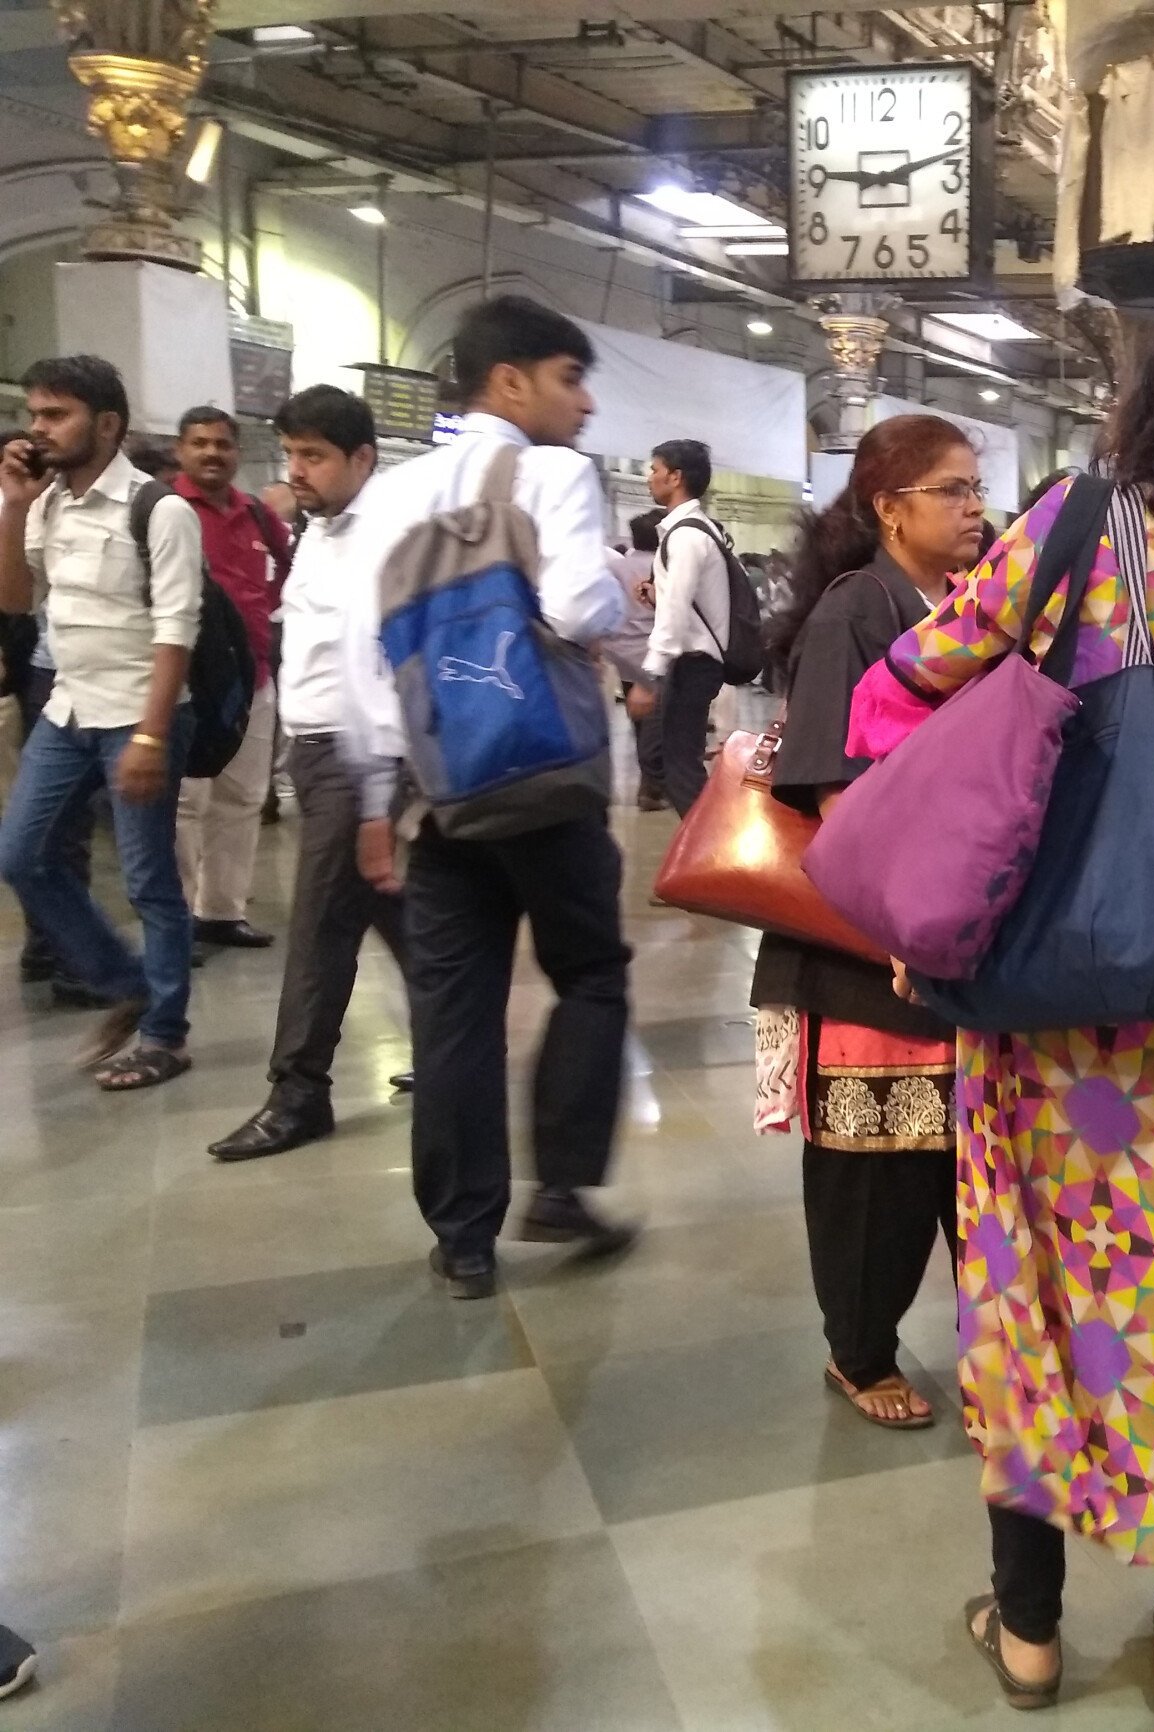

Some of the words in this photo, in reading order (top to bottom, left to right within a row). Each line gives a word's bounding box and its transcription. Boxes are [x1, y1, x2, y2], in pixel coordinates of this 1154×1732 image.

[841, 92, 857, 123] 11
[870, 87, 897, 122] 12
[807, 116, 830, 151] 10
[942, 110, 964, 146] 2
[808, 163, 828, 198] 9
[941, 158, 963, 195] 3
[808, 211, 829, 246] 8
[939, 208, 963, 243] 4
[840, 235, 861, 270] 7
[873, 234, 895, 270] 6
[907, 234, 930, 270] 5
